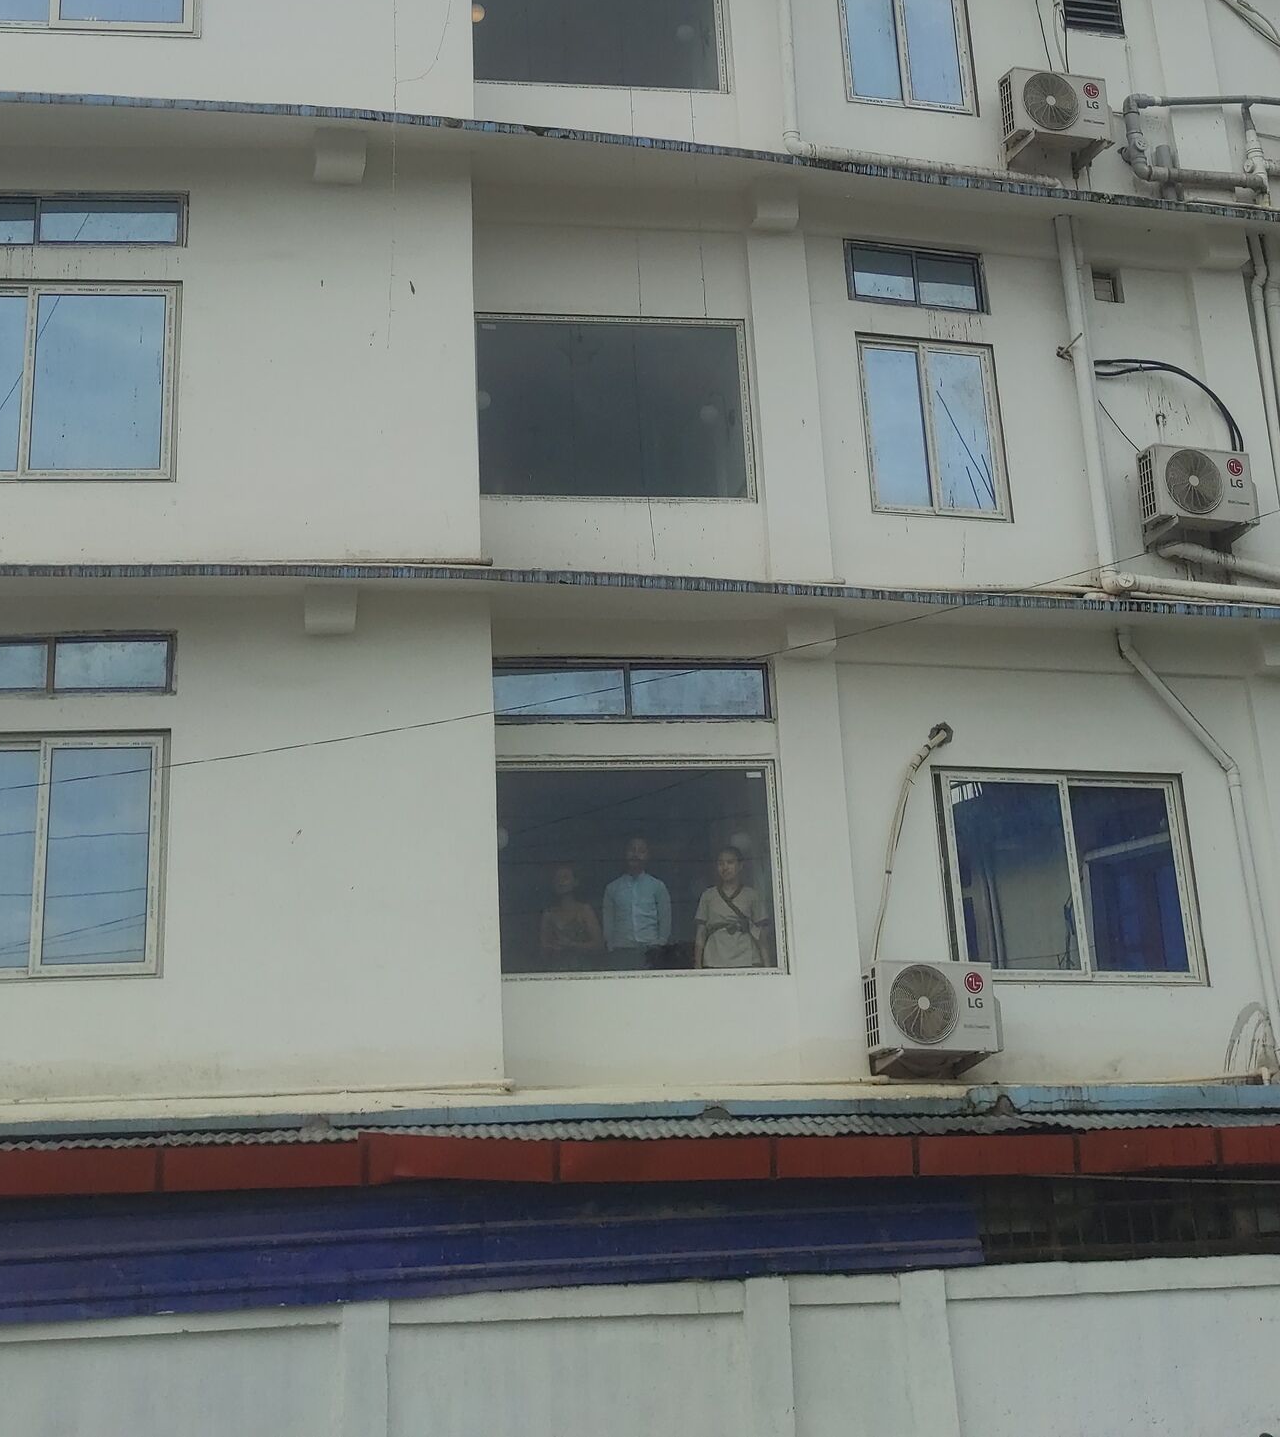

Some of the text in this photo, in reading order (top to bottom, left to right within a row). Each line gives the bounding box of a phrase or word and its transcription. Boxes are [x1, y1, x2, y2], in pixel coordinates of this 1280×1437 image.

[1086, 100, 1099, 109] LG
[1230, 478, 1243, 488] LG
[967, 997, 984, 1008] LG
